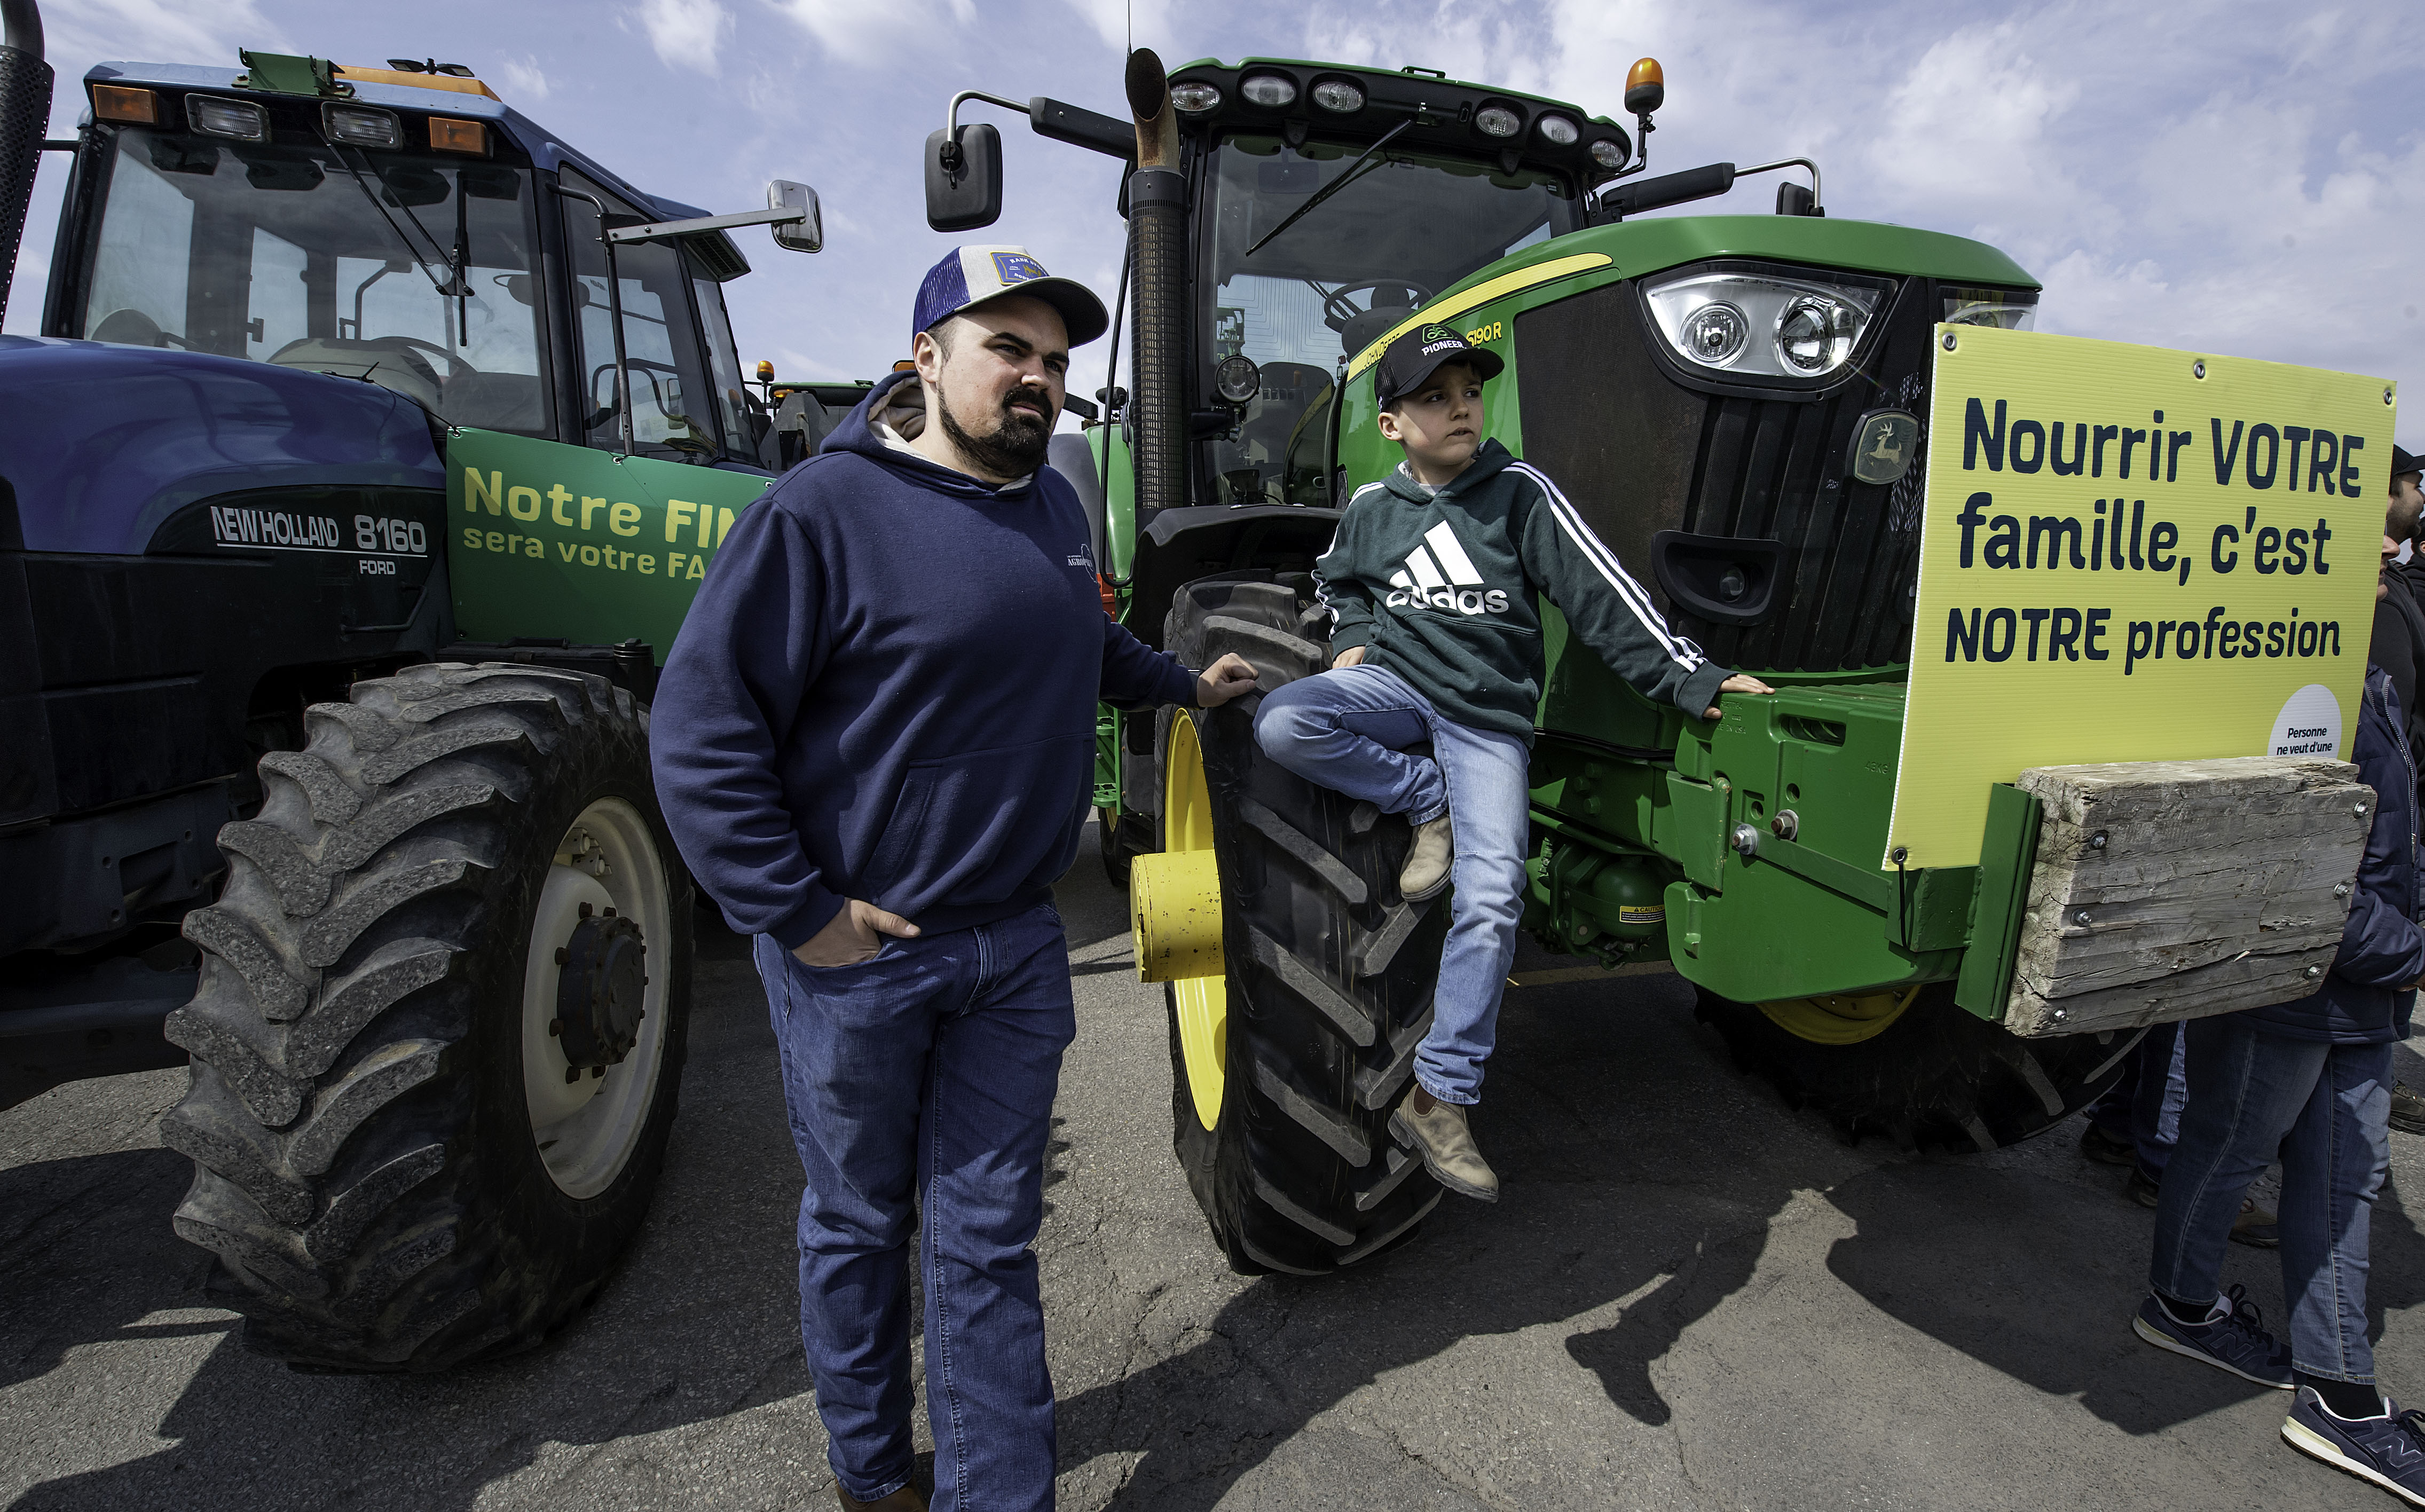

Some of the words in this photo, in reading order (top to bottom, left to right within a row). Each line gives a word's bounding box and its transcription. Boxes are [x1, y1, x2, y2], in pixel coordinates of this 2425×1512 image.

[1421, 340, 1464, 357] PIONEER
[1963, 398, 2192, 482] Nourrir
[2211, 418, 2365, 498] VOTRE
[464, 467, 641, 537] Notre
[210, 506, 257, 542] NEW
[259, 510, 339, 547] HOLLAND
[355, 515, 427, 553] 8160
[463, 528, 545, 559] sera
[557, 541, 656, 574] votre
[1957, 491, 2191, 586] famille,
[2211, 506, 2332, 575] c'est
[359, 560, 396, 575] FORD
[1386, 585, 1509, 615] adidas
[1945, 607, 2111, 663] NOTRE
[2124, 606, 2341, 676] profession
[2277, 745, 2288, 755] ne
[2290, 742, 2309, 754] veut
[2310, 741, 2332, 753] d'une
[2288, 728, 2327, 738] Personne
